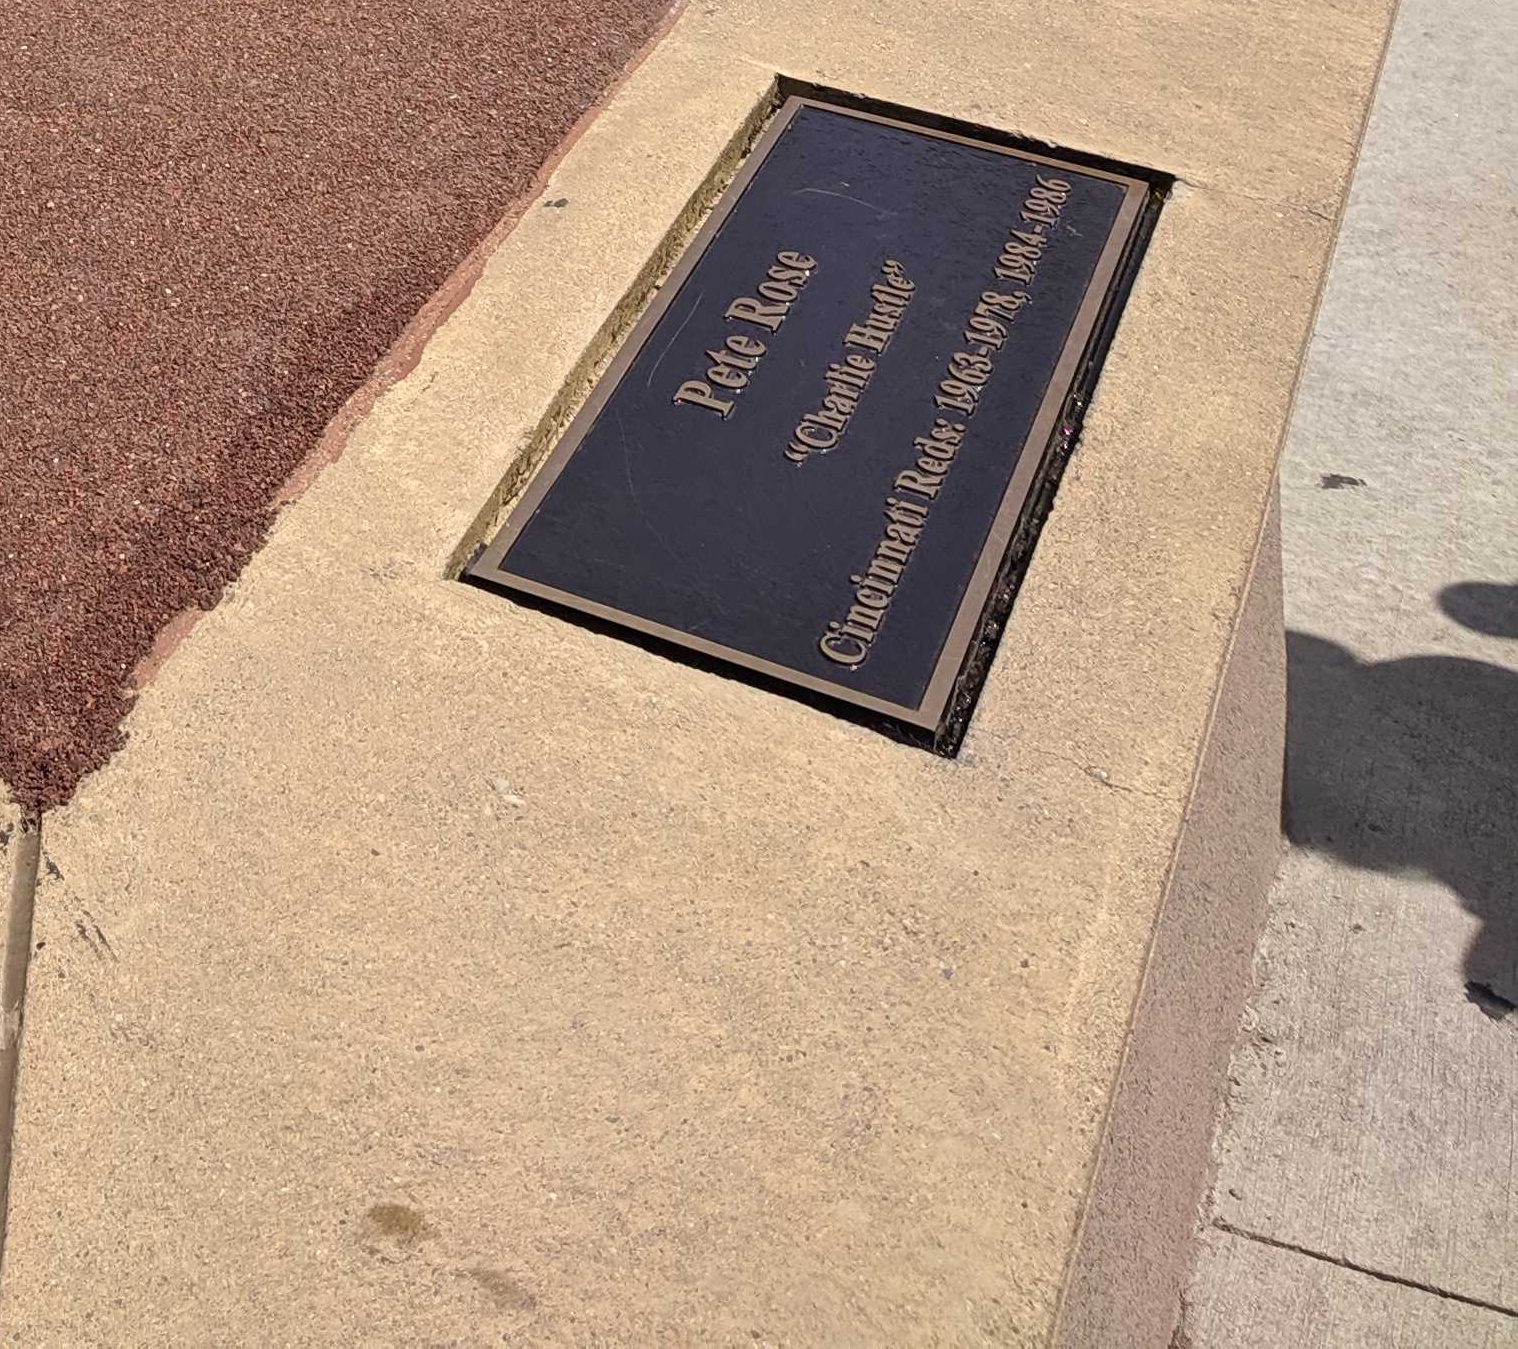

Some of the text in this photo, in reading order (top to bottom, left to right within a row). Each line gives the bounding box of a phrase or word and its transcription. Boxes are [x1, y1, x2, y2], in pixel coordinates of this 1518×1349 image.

[672, 250, 819, 421] Pete Rose
[818, 174, 1073, 670] Cincinnati Reds: 1963-1978, 1984-1986
